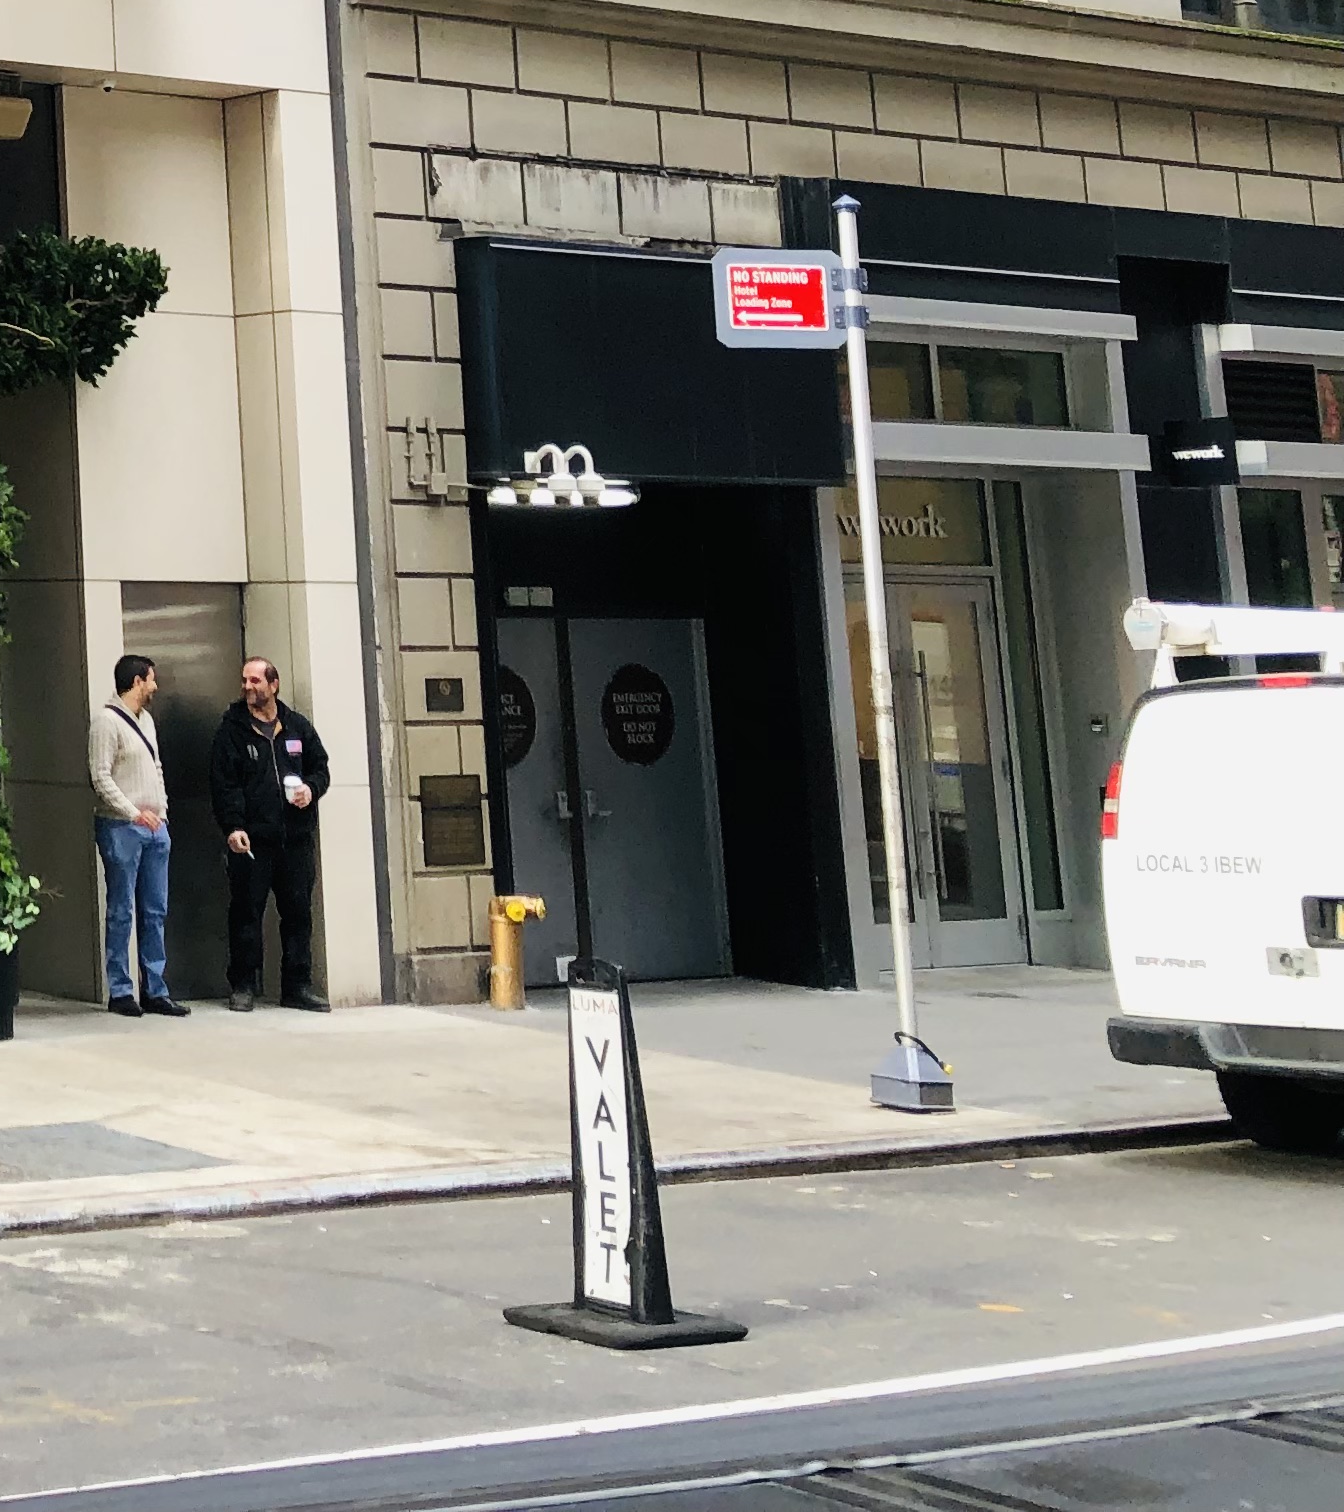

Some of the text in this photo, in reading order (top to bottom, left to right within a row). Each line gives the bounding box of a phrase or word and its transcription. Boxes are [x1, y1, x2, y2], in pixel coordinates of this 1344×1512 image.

[733, 270, 809, 285] NO STANDING
[734, 285, 758, 296] Hotel
[734, 297, 793, 310] Loading Zone
[1171, 444, 1226, 461] wework
[833, 503, 950, 538] wwork
[615, 704, 634, 715] EXIT
[1136, 854, 1263, 875] LOCAL 3 IBEW
[572, 994, 619, 1016] LUMA
[584, 1035, 619, 1285] VALET
